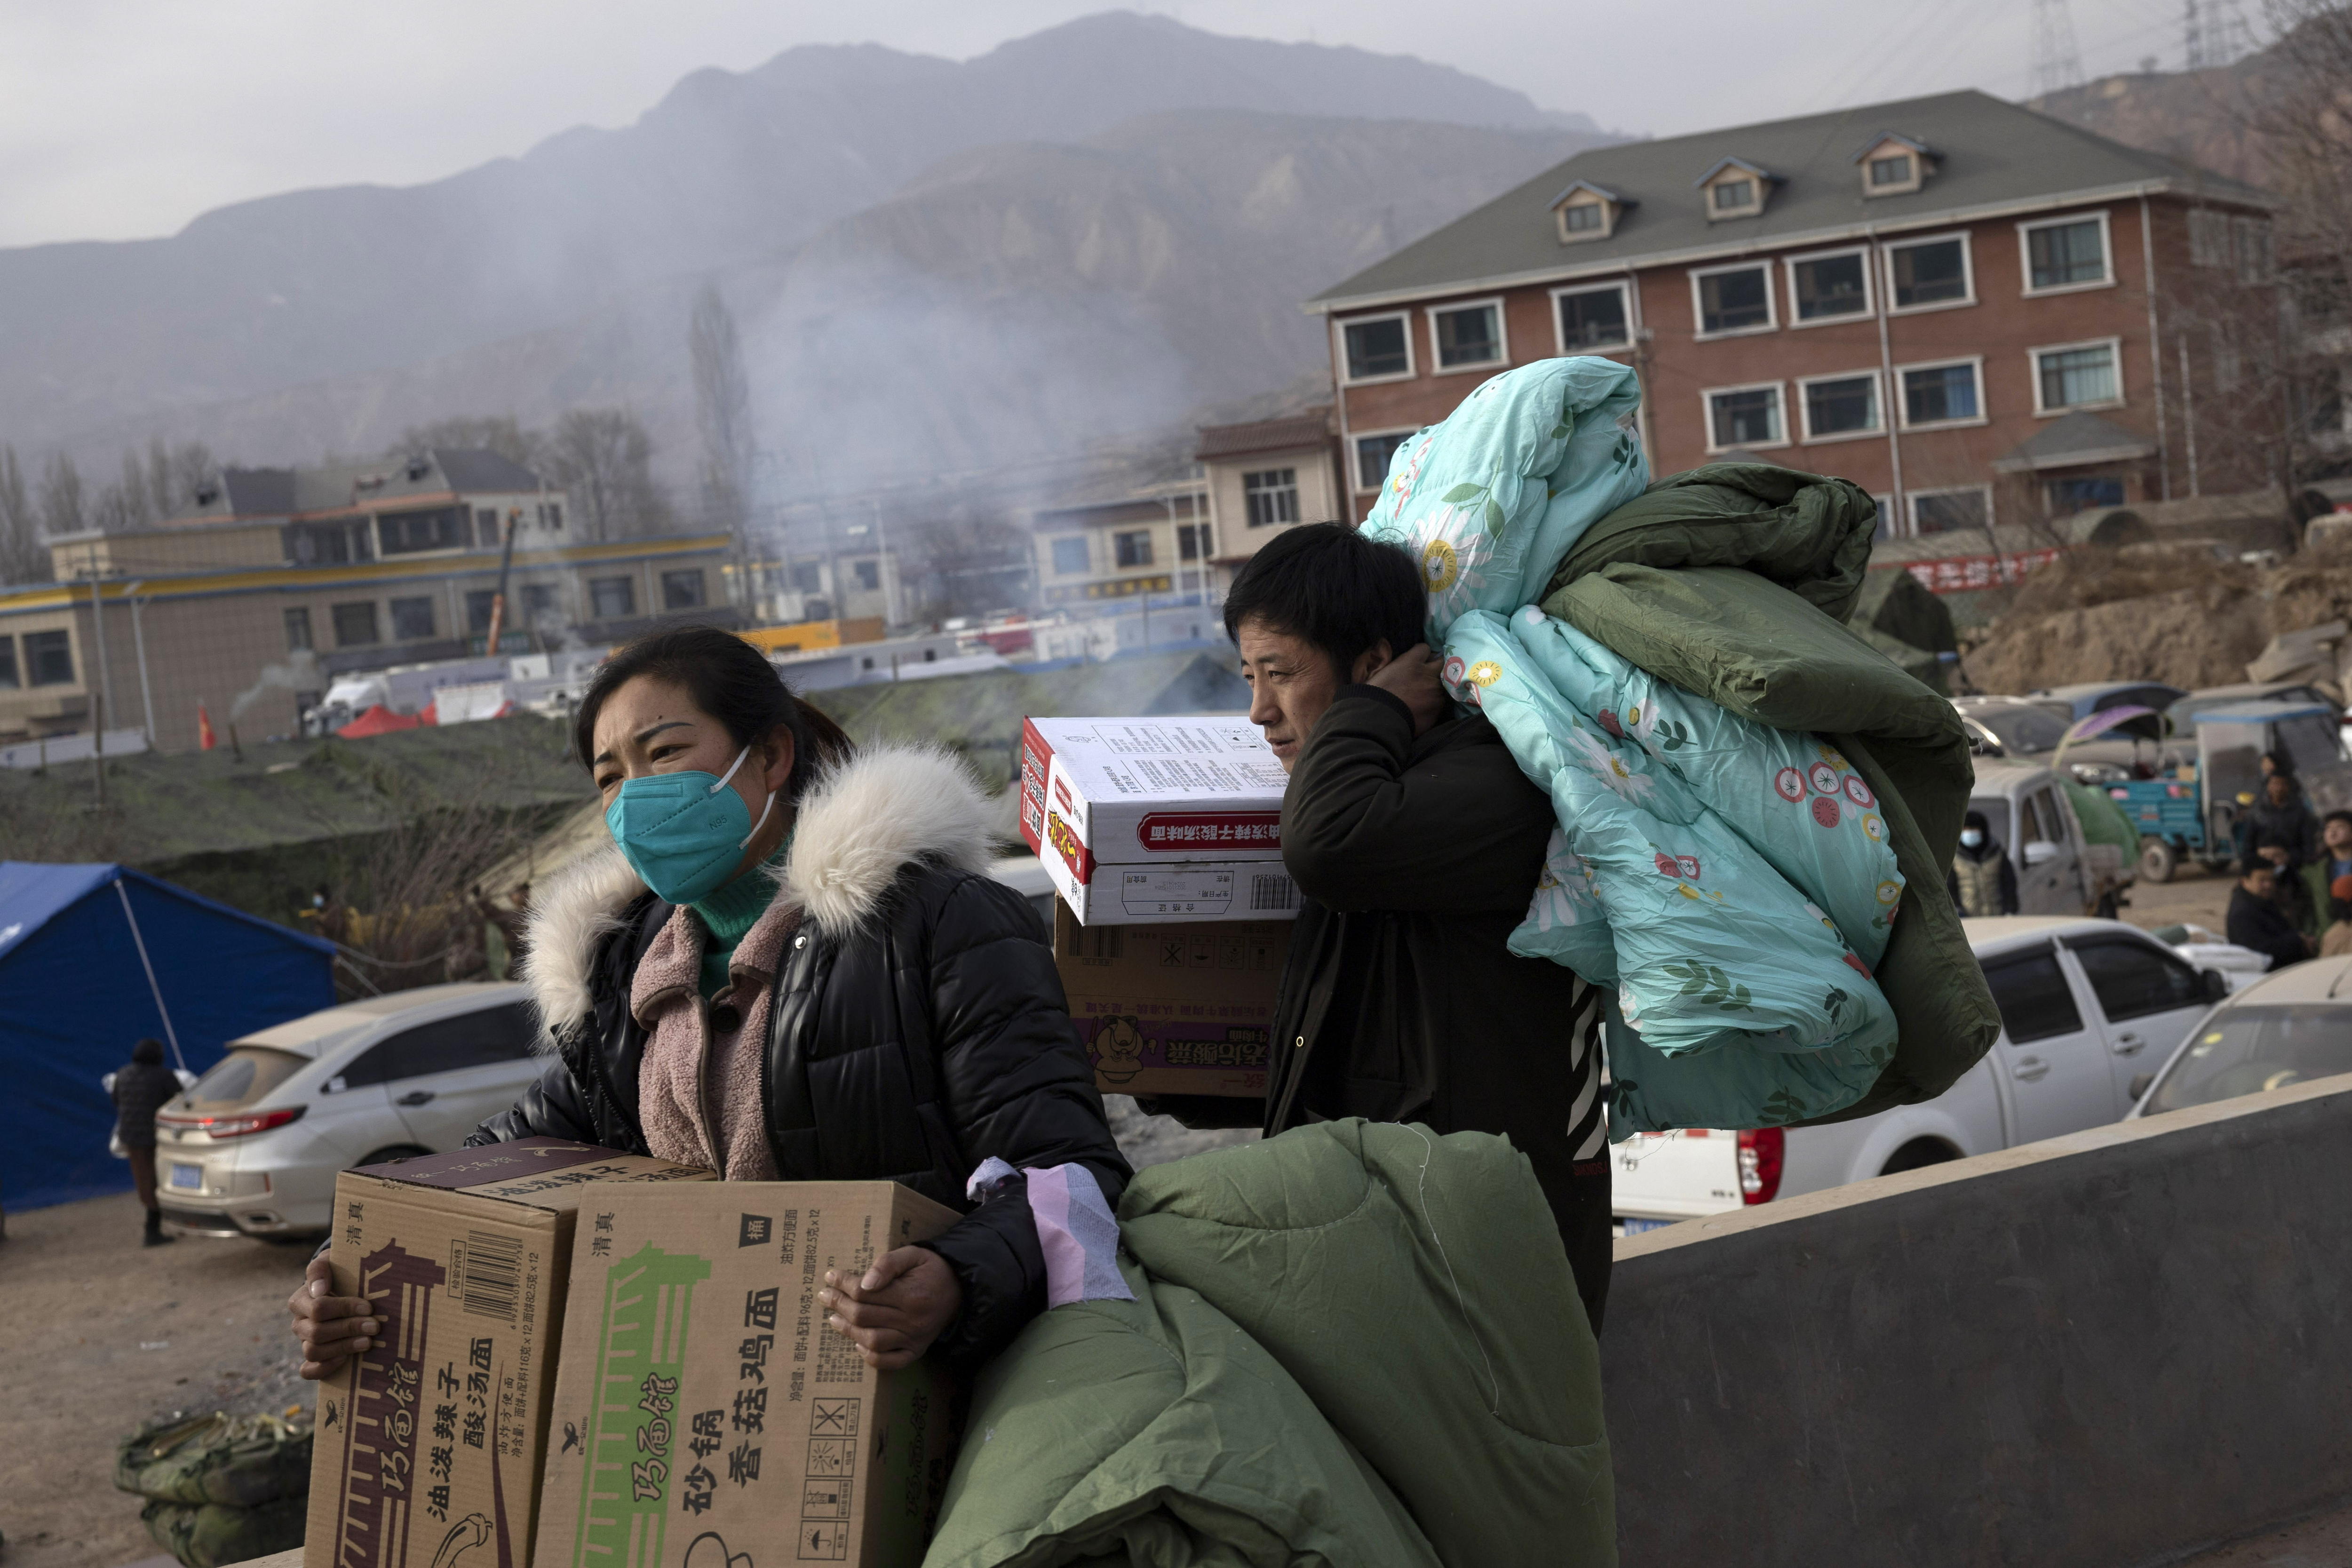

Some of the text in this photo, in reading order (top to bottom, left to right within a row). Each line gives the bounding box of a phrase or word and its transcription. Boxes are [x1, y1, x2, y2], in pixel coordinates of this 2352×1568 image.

[1158, 903, 1195, 912] 合格证
[1085, 1002, 1266, 1016] 认准统一是关键 老坛酸菜牛肉面
[1168, 1041, 1267, 1065] 老坛酸菜
[1229, 1030, 1269, 1043] 牛肉面
[483, 1165, 630, 1197] 油泼辣子
[610, 1167, 709, 1183] 汤面
[346, 1202, 364, 1246] 清真
[592, 1212, 615, 1257] 清真
[748, 1219, 765, 1241] 桶
[780, 1209, 798, 1265] 油炸方便面
[452, 1246, 462, 1291] 检验合格
[463, 1337, 493, 1450] 酸汤面
[728, 1286, 779, 1489] 香菇鸡面
[380, 1361, 421, 1493] 巧面馆
[498, 1377, 513, 1455] 油炸方便面
[632, 1371, 678, 1502] 巧面馆
[426, 1361, 460, 1523] 油泼辣子
[683, 1409, 724, 1517] 砂锅
